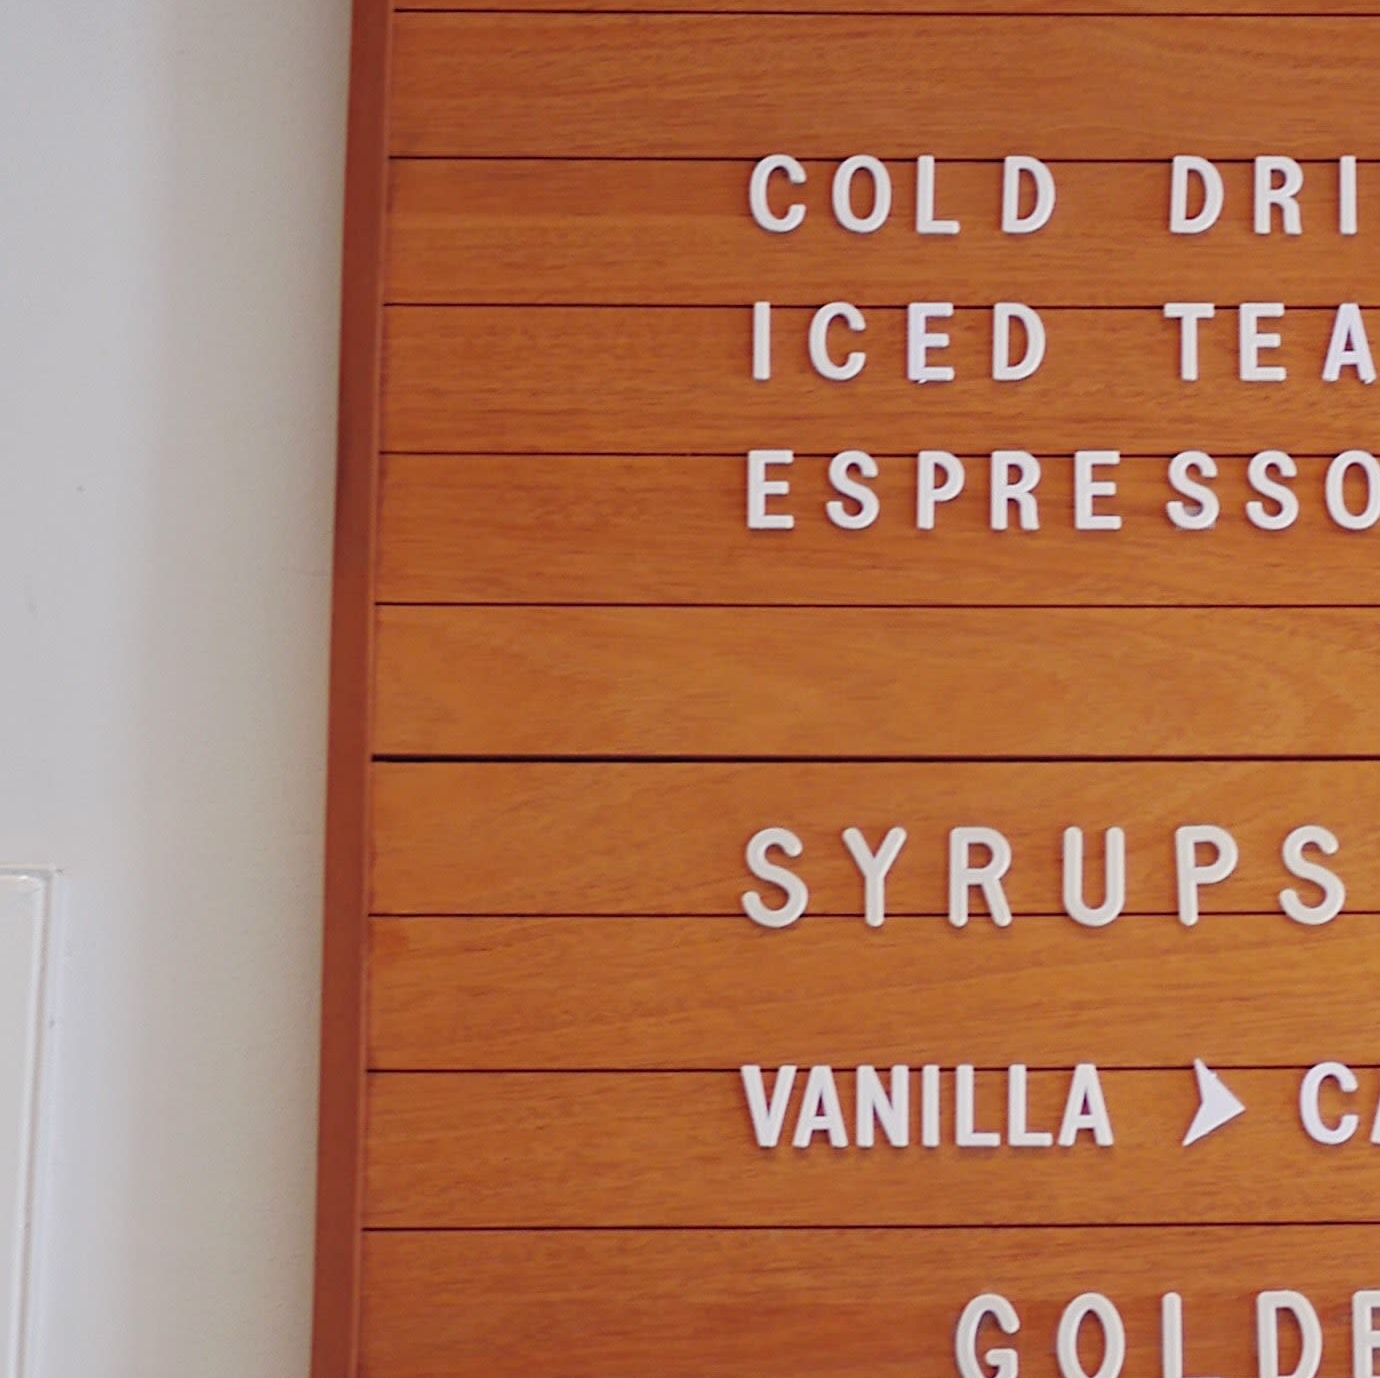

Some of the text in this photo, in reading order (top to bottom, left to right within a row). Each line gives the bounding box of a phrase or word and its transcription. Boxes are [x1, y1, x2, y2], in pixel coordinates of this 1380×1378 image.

[748, 153, 1057, 235] COLD
[752, 301, 1377, 384] ICED TEA
[741, 824, 1346, 928] SYRUPS
[740, 1061, 1114, 1149] VANILLA
